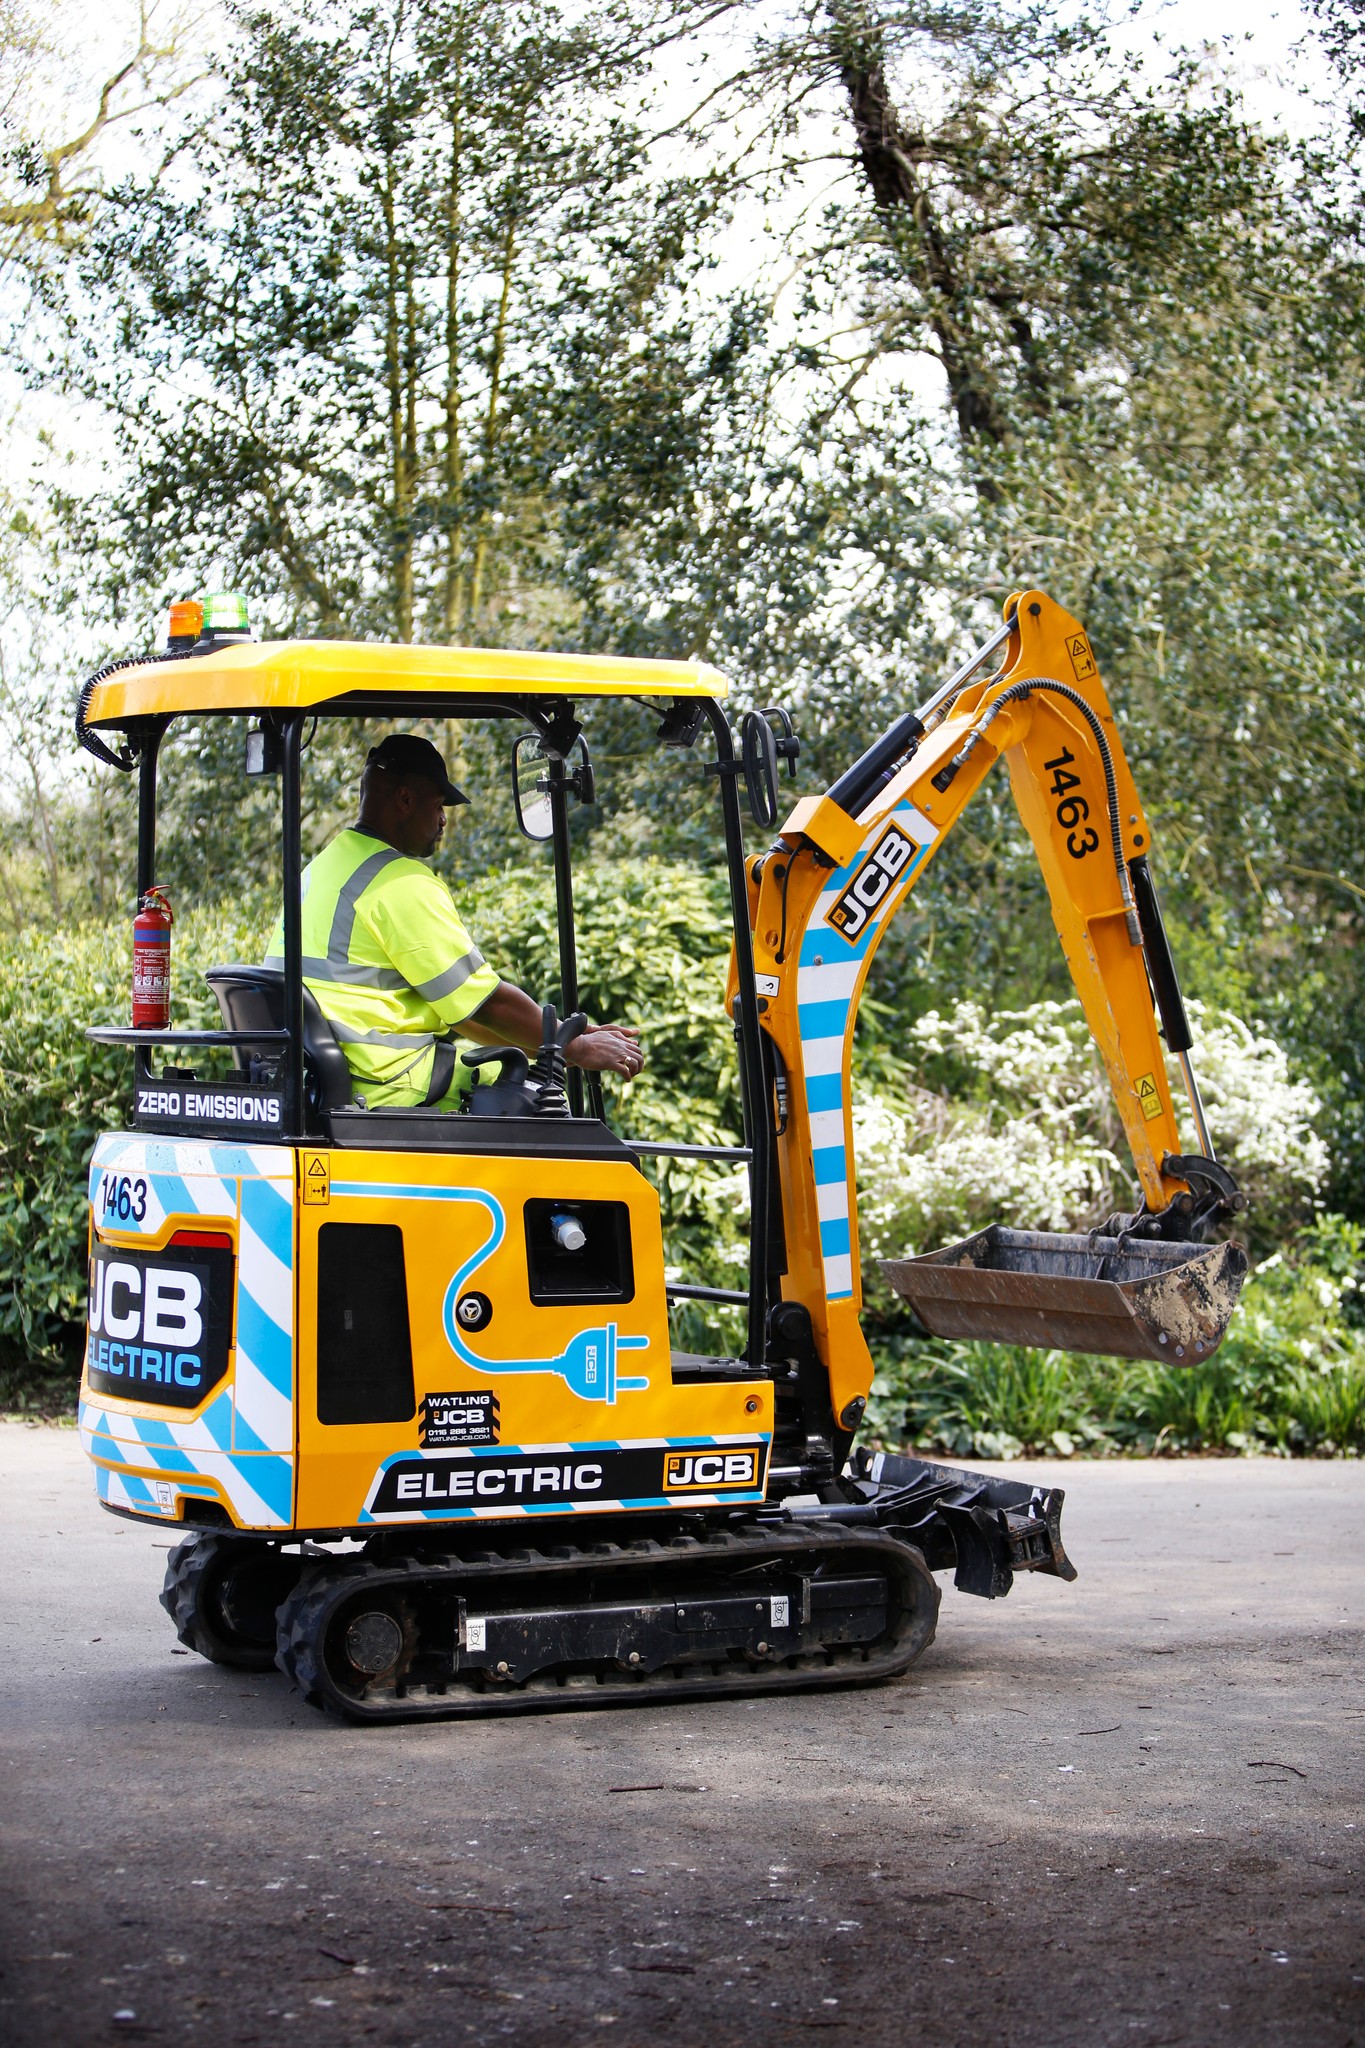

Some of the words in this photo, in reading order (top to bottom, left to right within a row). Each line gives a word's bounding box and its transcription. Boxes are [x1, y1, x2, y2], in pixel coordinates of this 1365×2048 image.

[1044, 746, 1099, 859] 1463
[843, 832, 912, 935] JCB
[138, 1091, 180, 1115] ZERO
[185, 1094, 280, 1122] EMISSIONS
[102, 1174, 147, 1222] 1463
[89, 1259, 202, 1347] JCB
[89, 1338, 201, 1387] ELECTRIC
[587, 1348, 595, 1381] JCB
[428, 1396, 490, 1407] WATLING
[433, 1409, 485, 1425] JCB
[429, 1434, 490, 1442] WATLING-JCB.COM
[397, 1464, 602, 1499] ELECTRIC
[669, 1455, 753, 1485] JCB
